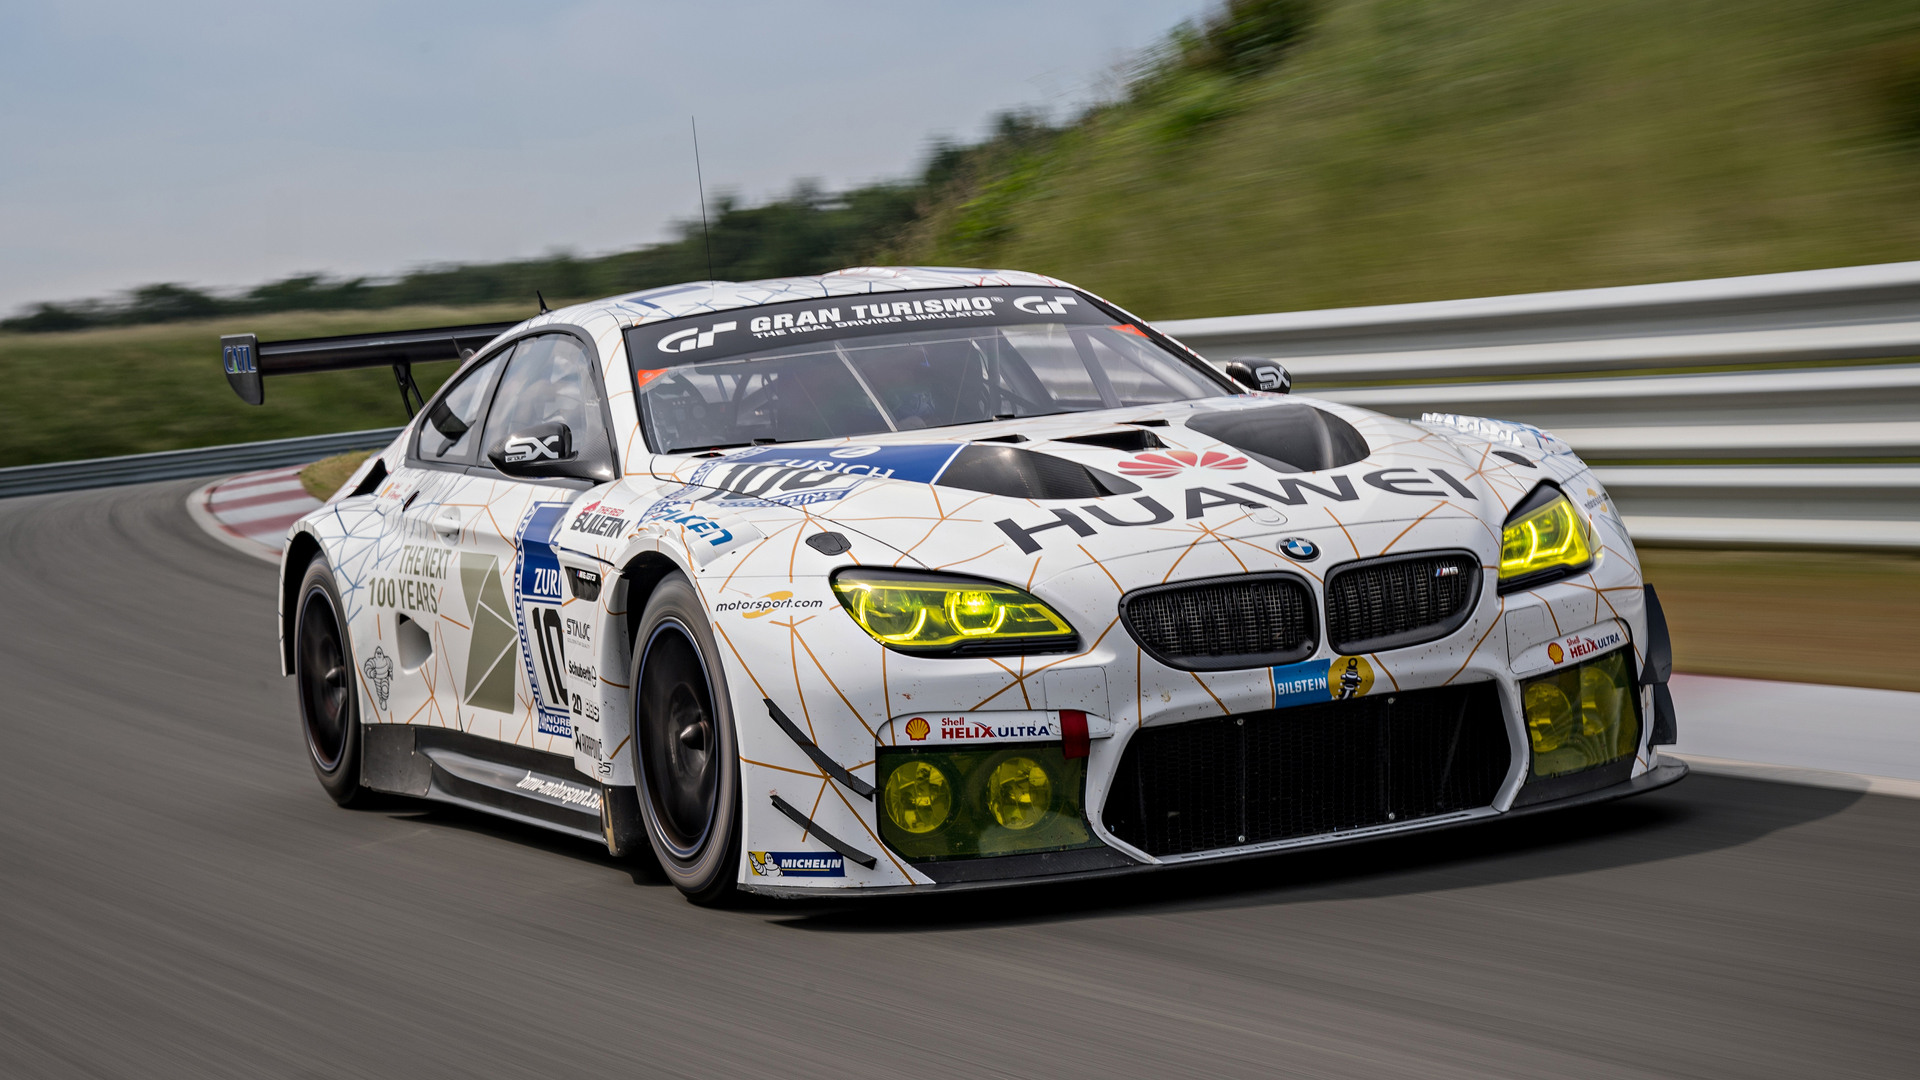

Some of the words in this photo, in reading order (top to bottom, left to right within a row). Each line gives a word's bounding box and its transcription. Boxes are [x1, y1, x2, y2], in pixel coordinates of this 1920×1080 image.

[750, 307, 841, 333] GRAN
[753, 329, 782, 339] THE
[791, 323, 832, 333] REAL
[837, 315, 902, 329] DRIVING
[905, 310, 996, 322] SIMULATOR
[223, 344, 257, 374] CATL
[504, 435, 559, 461] SX
[994, 467, 1478, 555] HUAWEI
[514, 504, 536, 566] ADAC
[570, 512, 630, 539] BULLETIN
[399, 545, 425, 575] THE
[422, 547, 452, 580] NEXT
[369, 577, 396, 608] 100
[398, 579, 438, 614] YEARS
[715, 597, 823, 612] motorsport.com
[1566, 635, 1580, 647] Shell
[1569, 640, 1599, 658] HELIX
[1597, 632, 1620, 649] ULTRA
[568, 660, 592, 682] Schuberth
[1277, 676, 1327, 696] BILSTEIN
[545, 723, 572, 736] NORD
[941, 726, 994, 739] HELIX
[998, 726, 1050, 738] ULTRA
[942, 717, 964, 726] Shell
[516, 770, 600, 811] bmw-motorsport.co
[781, 858, 842, 869] MICHELIN
